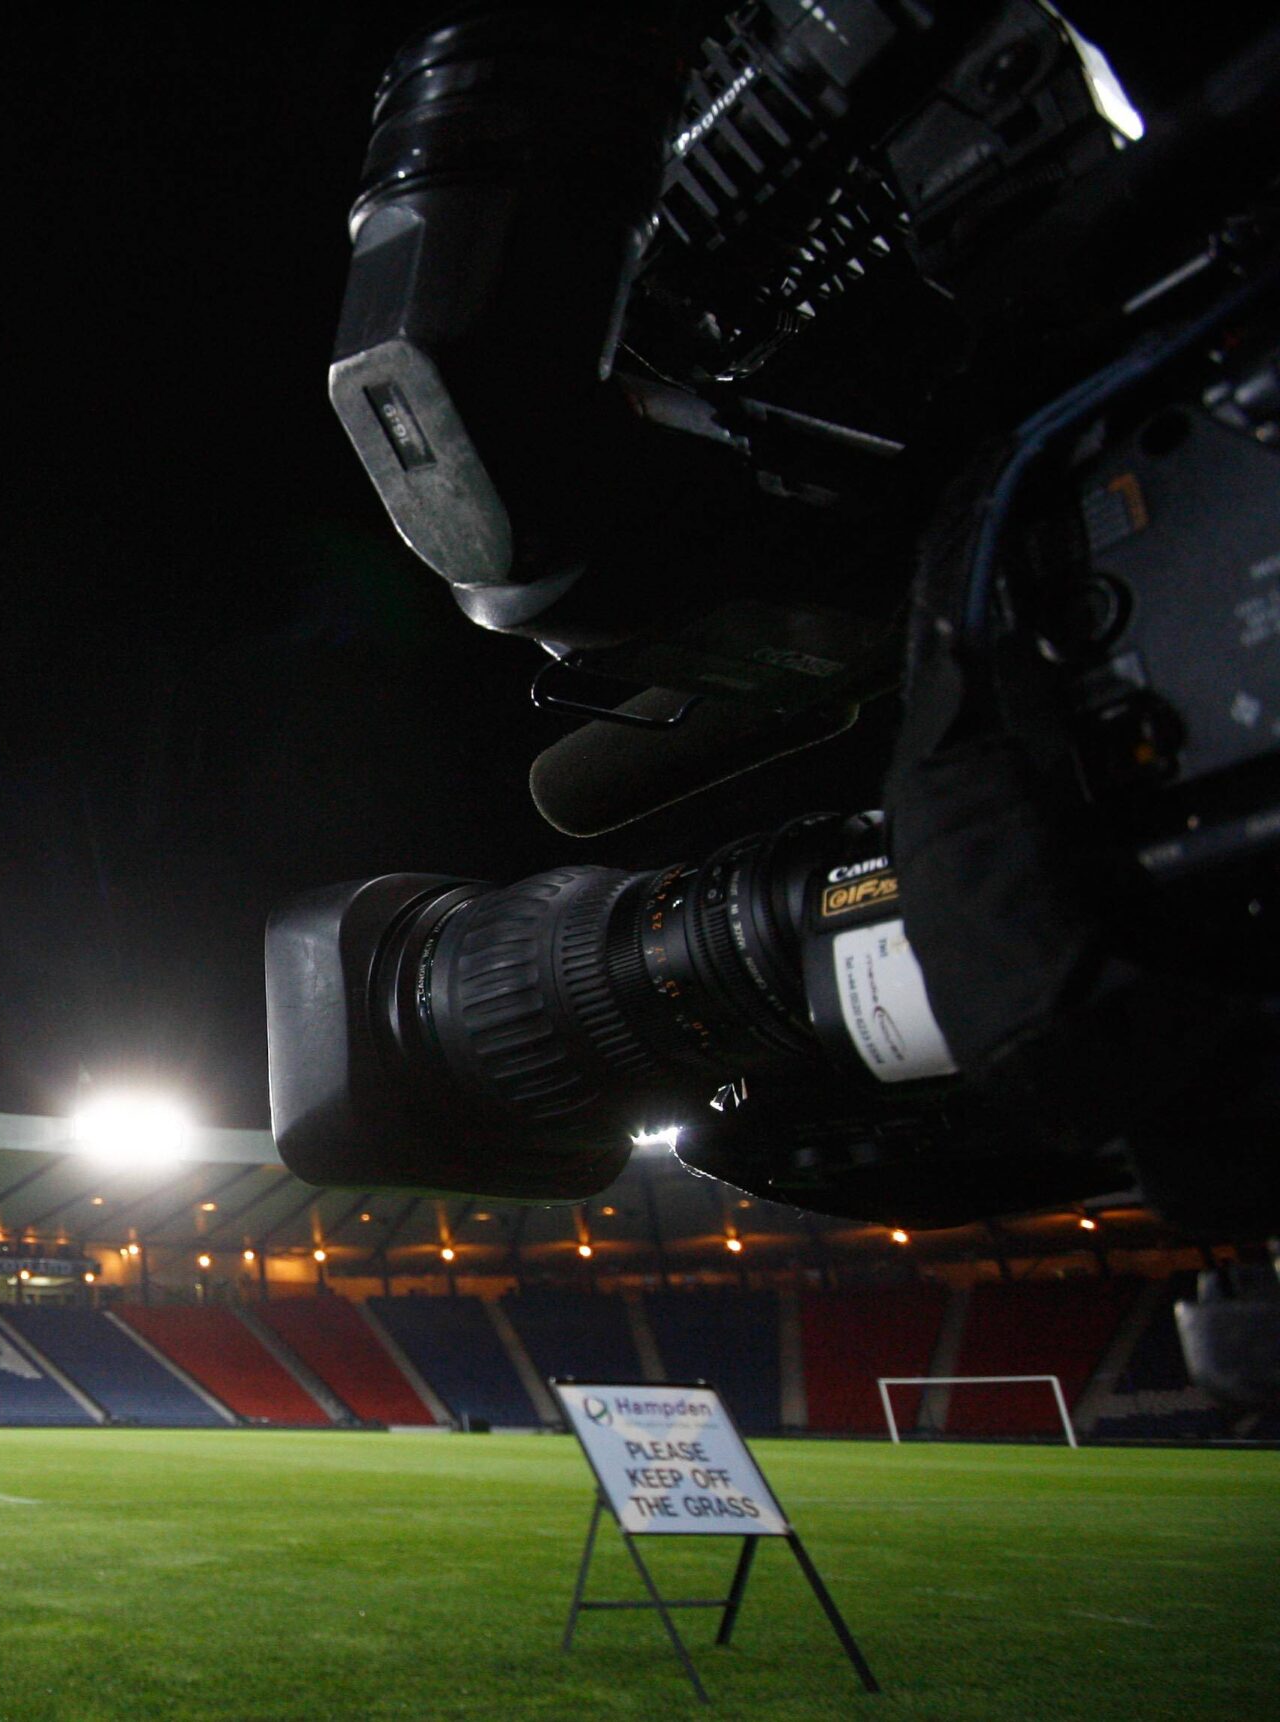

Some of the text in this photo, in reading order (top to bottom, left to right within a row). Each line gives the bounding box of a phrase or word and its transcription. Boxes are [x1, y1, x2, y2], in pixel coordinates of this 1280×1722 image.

[673, 66, 756, 152] Paglight
[827, 855, 891, 883] Cano
[615, 1398, 713, 1417] Hampden
[625, 1441, 709, 1461] PLEASE
[625, 1468, 732, 1489] KEEP OFF
[628, 1496, 760, 1518] THE GRASS
